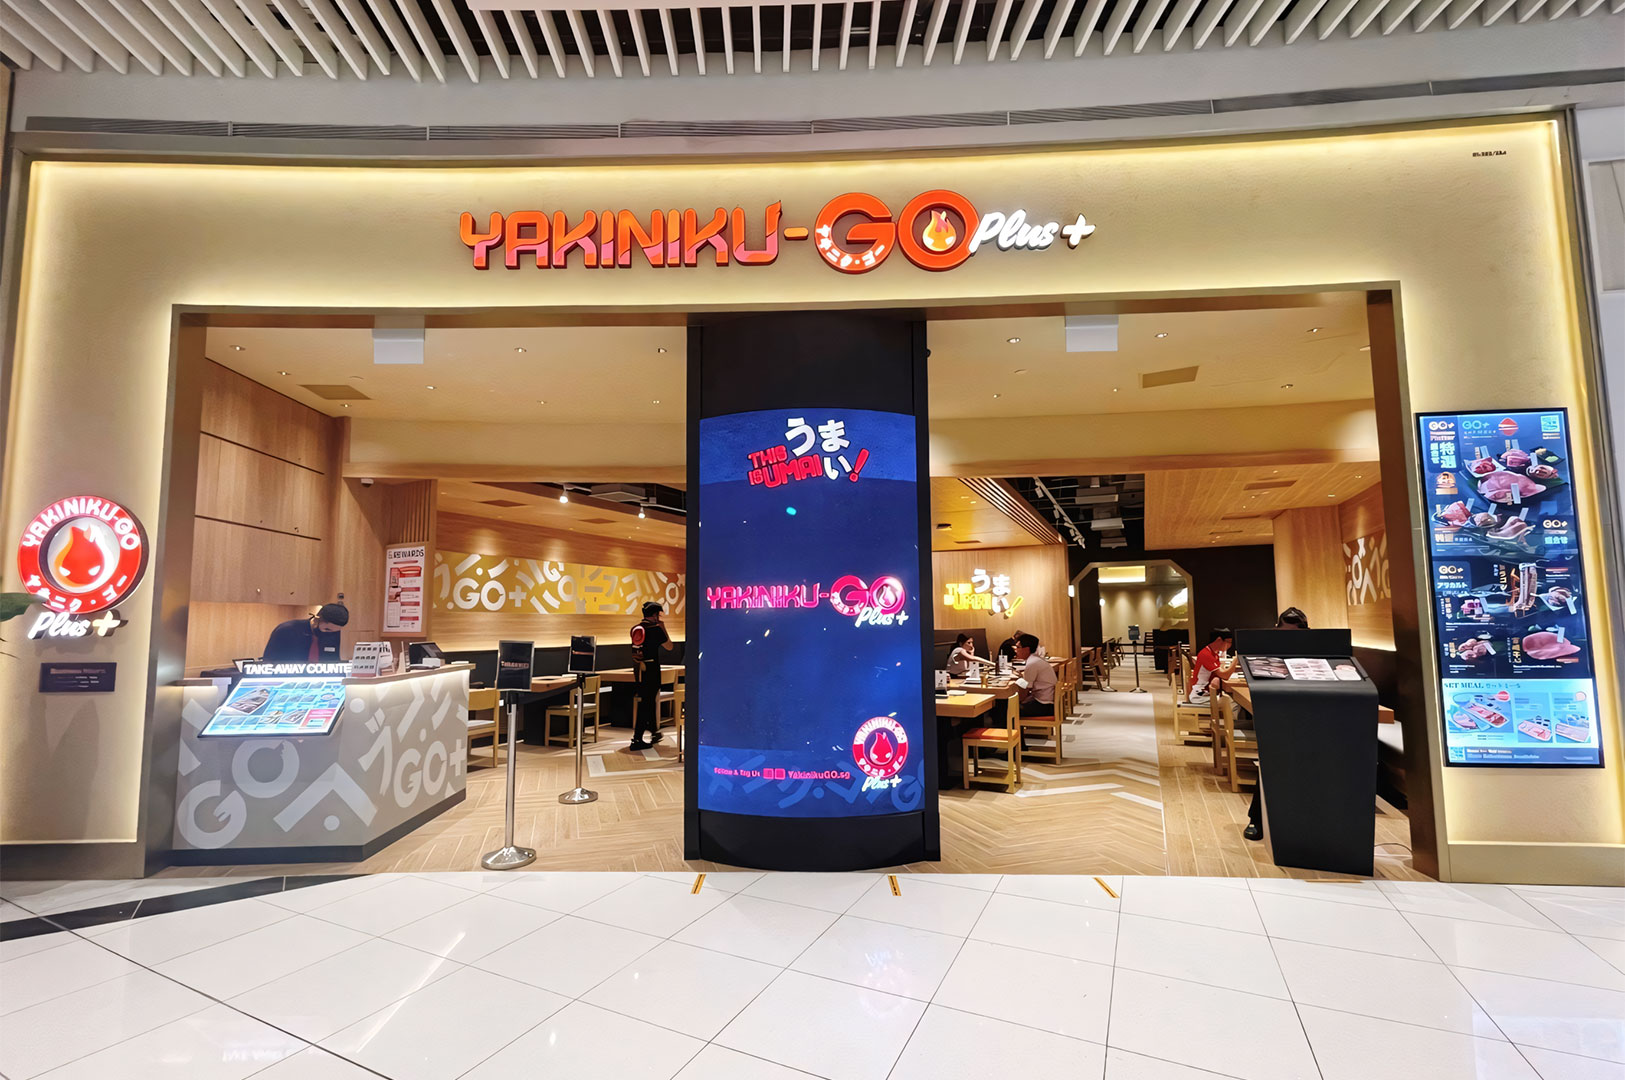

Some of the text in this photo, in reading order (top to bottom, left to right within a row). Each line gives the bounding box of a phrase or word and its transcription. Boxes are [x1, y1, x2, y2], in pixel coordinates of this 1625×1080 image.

[460, 189, 980, 274] YAKINIKU-GO
[748, 445, 787, 468] THIS
[762, 454, 823, 488] UMAI
[22, 498, 141, 551] YAKINIKU-GO
[453, 577, 527, 612] GO+
[706, 575, 906, 616] YAKINIKU-GO
[244, 663, 352, 675] TAKE-AWAY COUNTE
